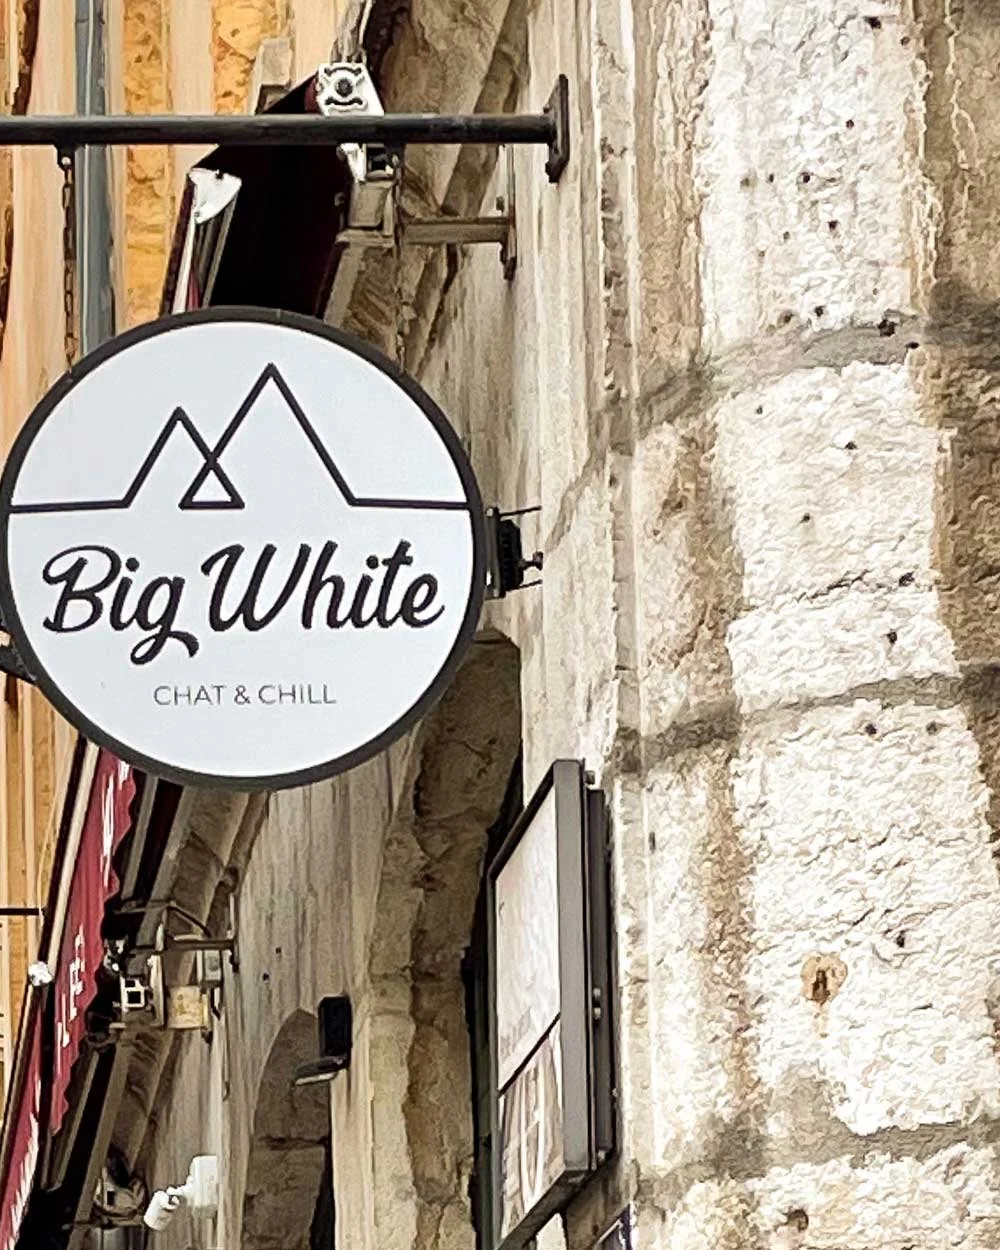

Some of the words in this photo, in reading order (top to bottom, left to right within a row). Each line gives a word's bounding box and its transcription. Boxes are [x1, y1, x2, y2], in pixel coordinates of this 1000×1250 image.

[42, 544, 200, 666] Big
[200, 539, 446, 632] White
[153, 684, 225, 706] CHAT
[233, 684, 252, 706] &
[257, 683, 337, 705] CHILL
